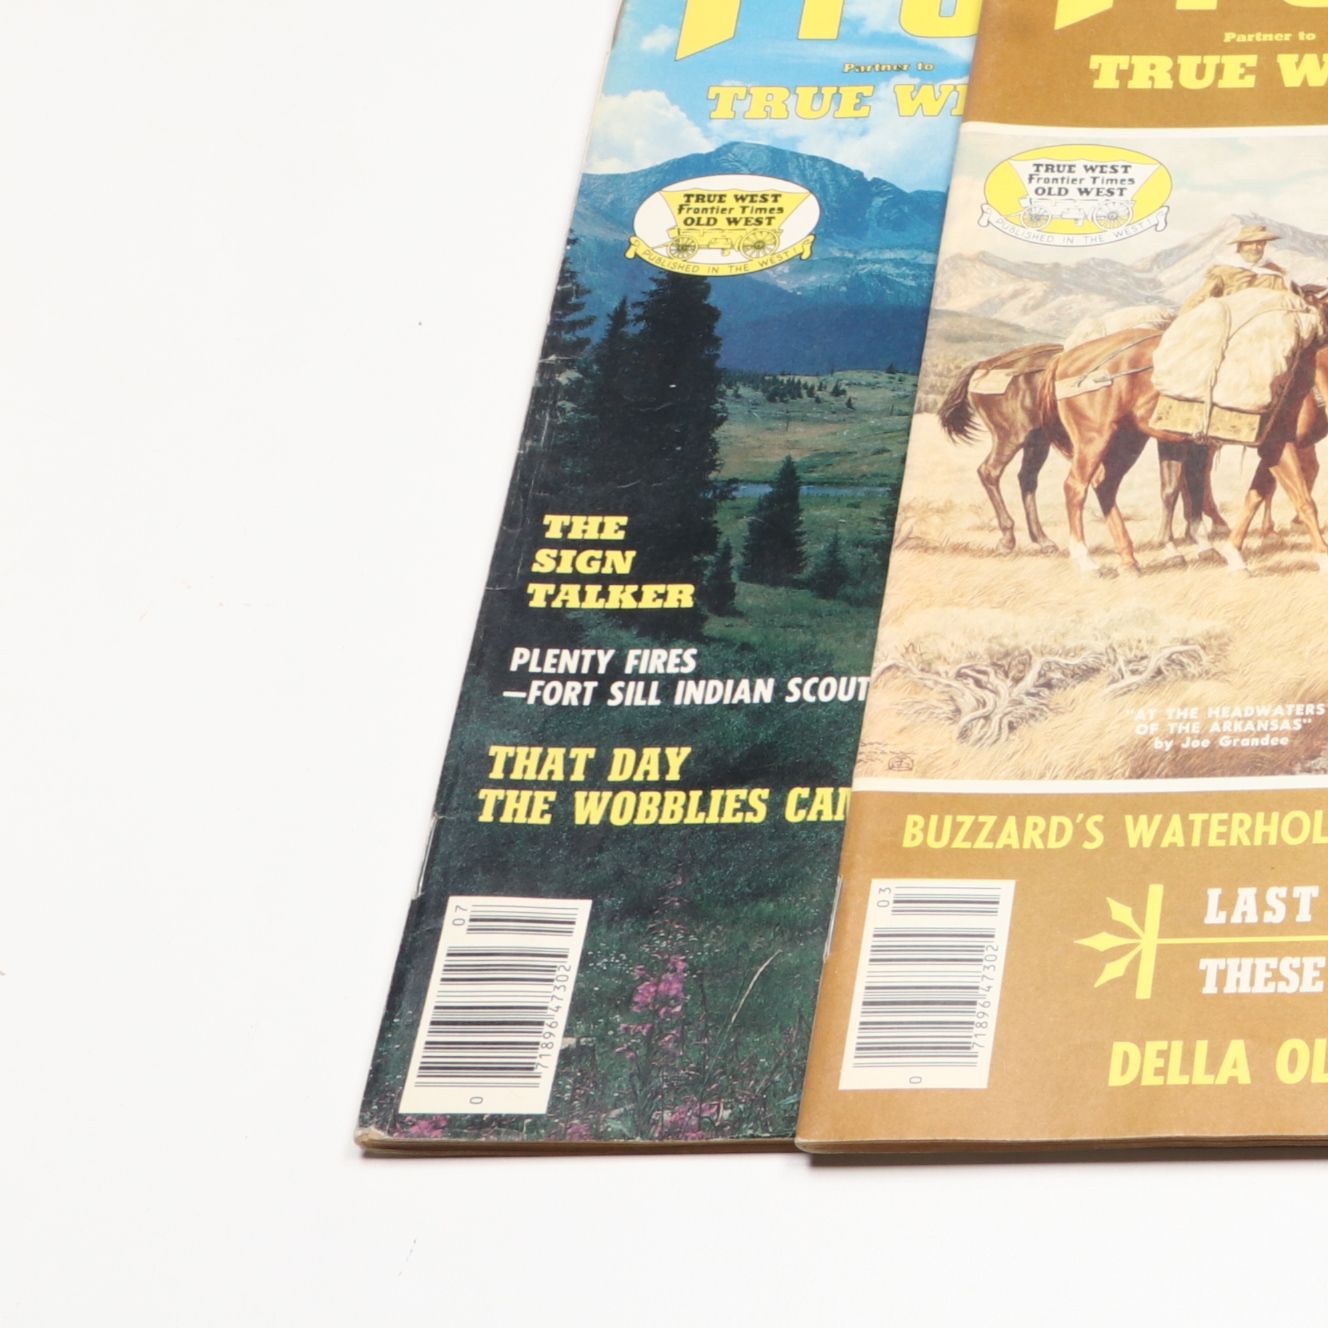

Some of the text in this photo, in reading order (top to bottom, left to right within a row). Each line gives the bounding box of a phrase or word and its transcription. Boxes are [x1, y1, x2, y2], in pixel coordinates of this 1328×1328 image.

[1089, 54, 1257, 89] TRUE
[678, 203, 784, 215] Frontier Times
[683, 193, 782, 204] TRUE WEST
[683, 216, 776, 226] OLD WEST
[543, 515, 628, 540] THE
[531, 550, 636, 574] SIGN
[527, 583, 696, 609] TALKER
[510, 647, 698, 673] PLENTY FIRES
[487, 745, 692, 781] THAT DAY
[477, 787, 769, 826] THE WOBBLIES
[902, 812, 1105, 850] BUZZARD'S
[1108, 1039, 1251, 1086] DELLA
